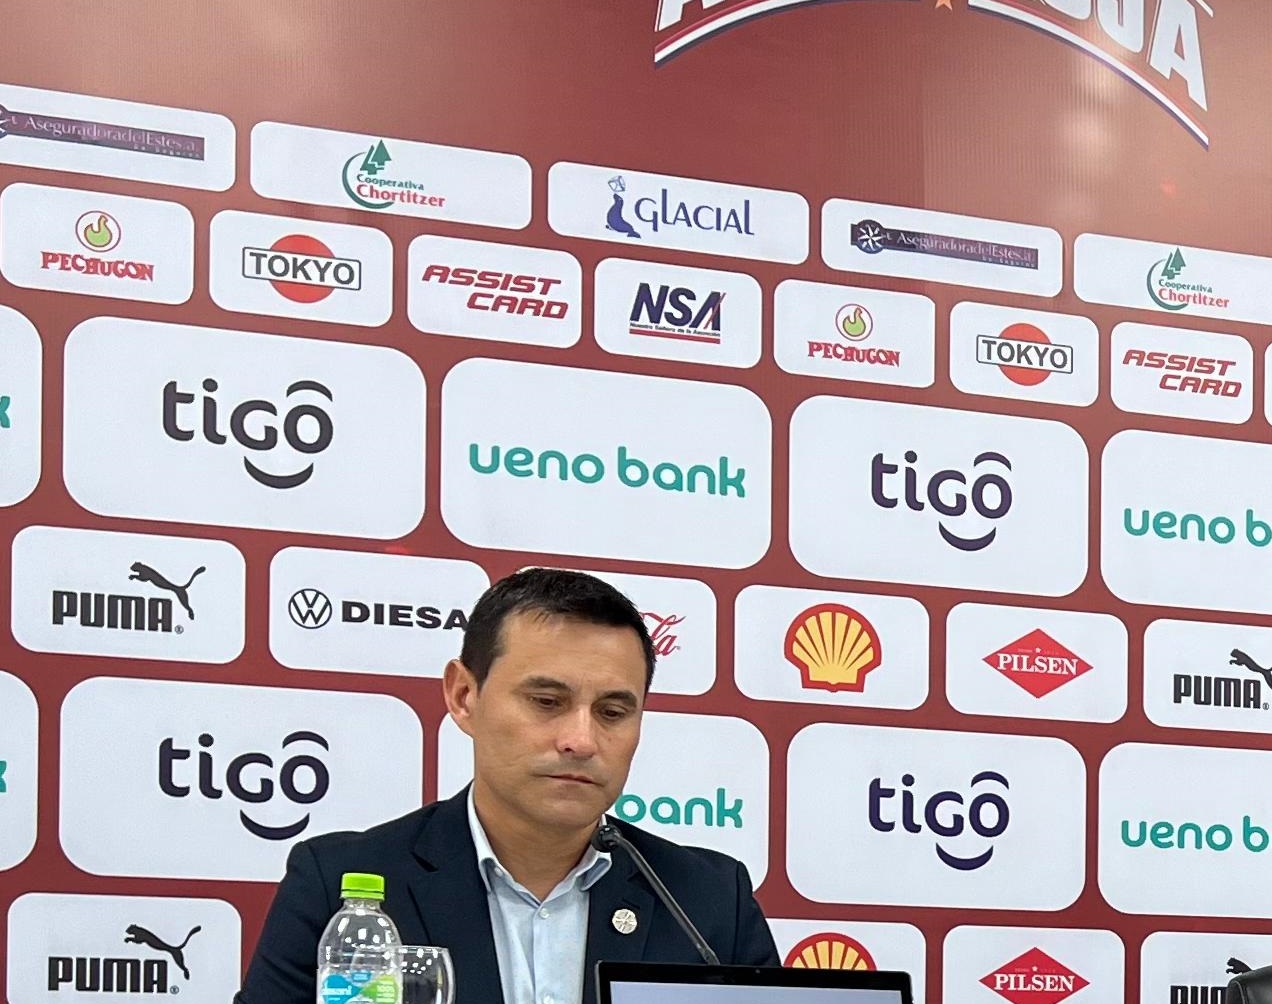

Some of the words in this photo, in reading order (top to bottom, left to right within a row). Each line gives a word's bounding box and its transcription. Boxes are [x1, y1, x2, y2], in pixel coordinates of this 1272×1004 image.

[356, 173, 425, 190] Cooperativa
[356, 183, 446, 208] Chortitzer
[634, 188, 755, 235] GLACIAL
[43, 252, 153, 281] PECHUGON
[250, 252, 354, 286] TOKYO
[422, 265, 561, 293] ASSIST
[1158, 278, 1214, 294] Cooperativa
[1158, 288, 1230, 308] Chortitzer
[468, 293, 568, 319] CARD
[630, 282, 725, 331] NSA
[808, 341, 900, 366] PECHUGON
[984, 341, 1067, 369] TOKYO
[1123, 350, 1236, 376] ASSIST
[1160, 375, 1242, 397] CARD
[469, 443, 605, 485] ueno
[617, 445, 747, 498] bank
[1123, 508, 1236, 545] ueno
[53, 591, 172, 632] PUMA
[342, 601, 469, 631] DIESA
[996, 653, 1078, 676] PILSEN
[1174, 673, 1261, 709] PUMA
[1121, 818, 1234, 852] ueno
[48, 957, 167, 993] PUMA
[993, 973, 1075, 992] PILSEN
